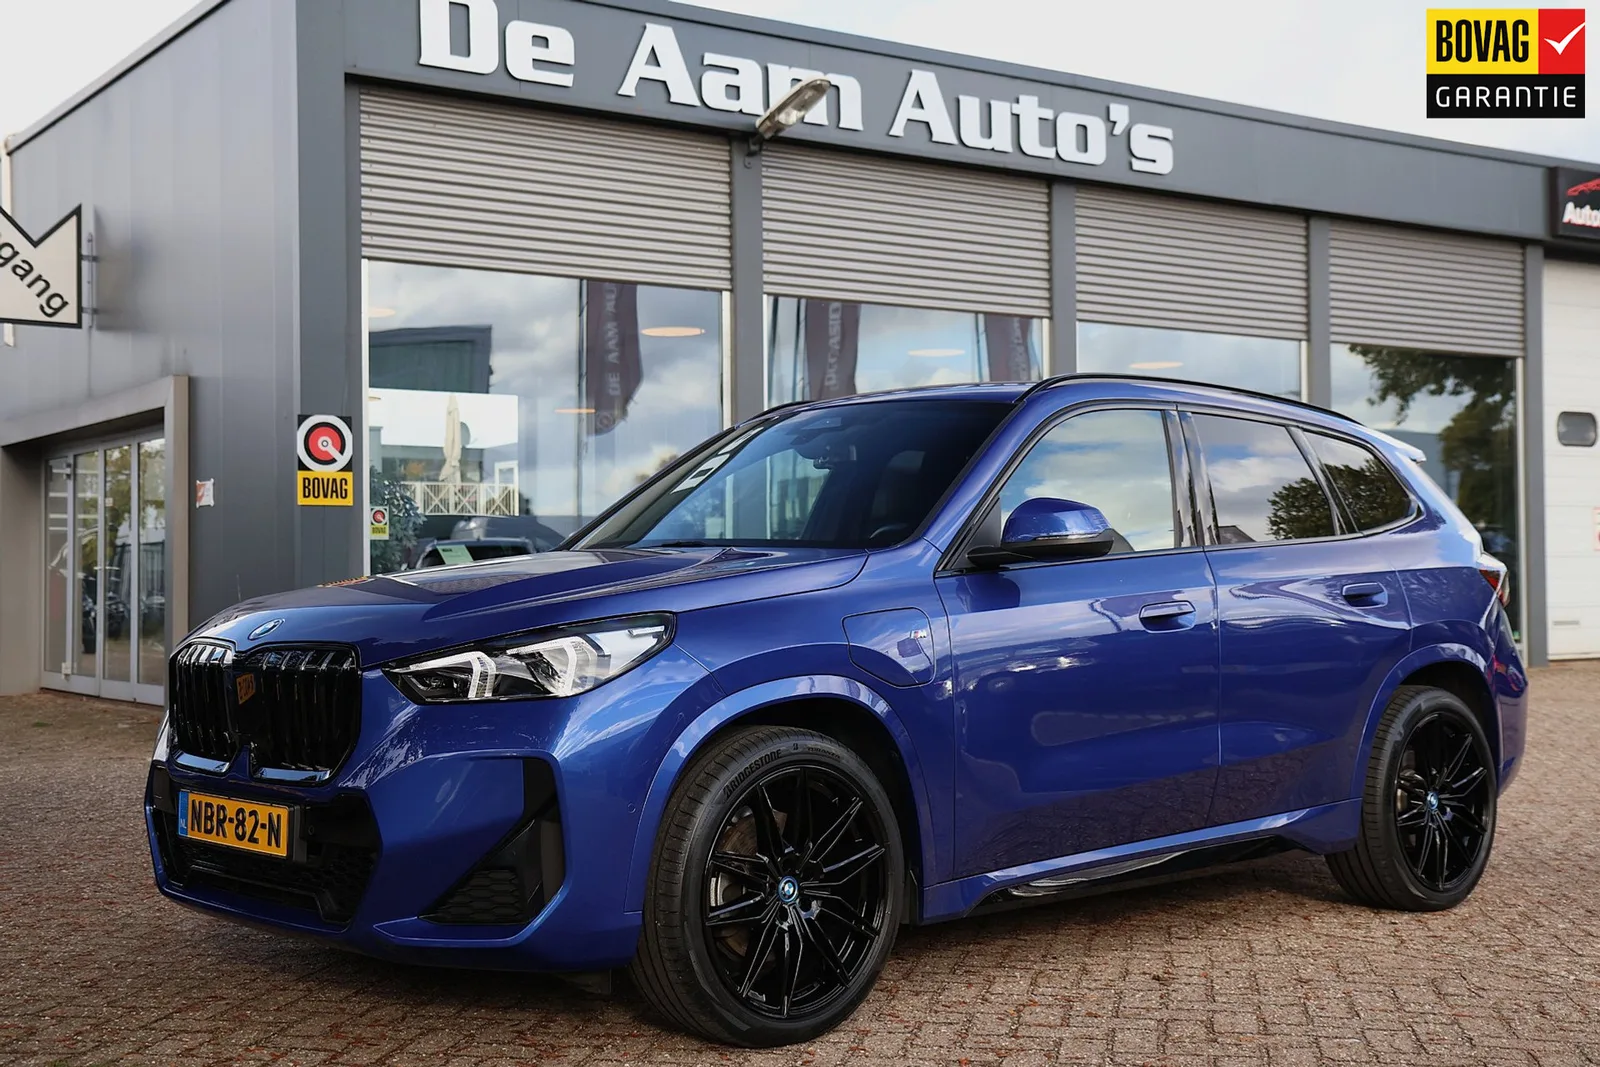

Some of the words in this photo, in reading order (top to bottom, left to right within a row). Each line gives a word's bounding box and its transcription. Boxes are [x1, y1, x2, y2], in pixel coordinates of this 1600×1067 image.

[419, 0, 575, 87] De
[617, 22, 864, 131] Aam
[888, 69, 1174, 175] Auto's
[1562, 201, 1600, 228] Auto
[0, 235, 69, 318] gang
[302, 477, 348, 499] BOVAG
[190, 799, 282, 849] NBR-82-N
